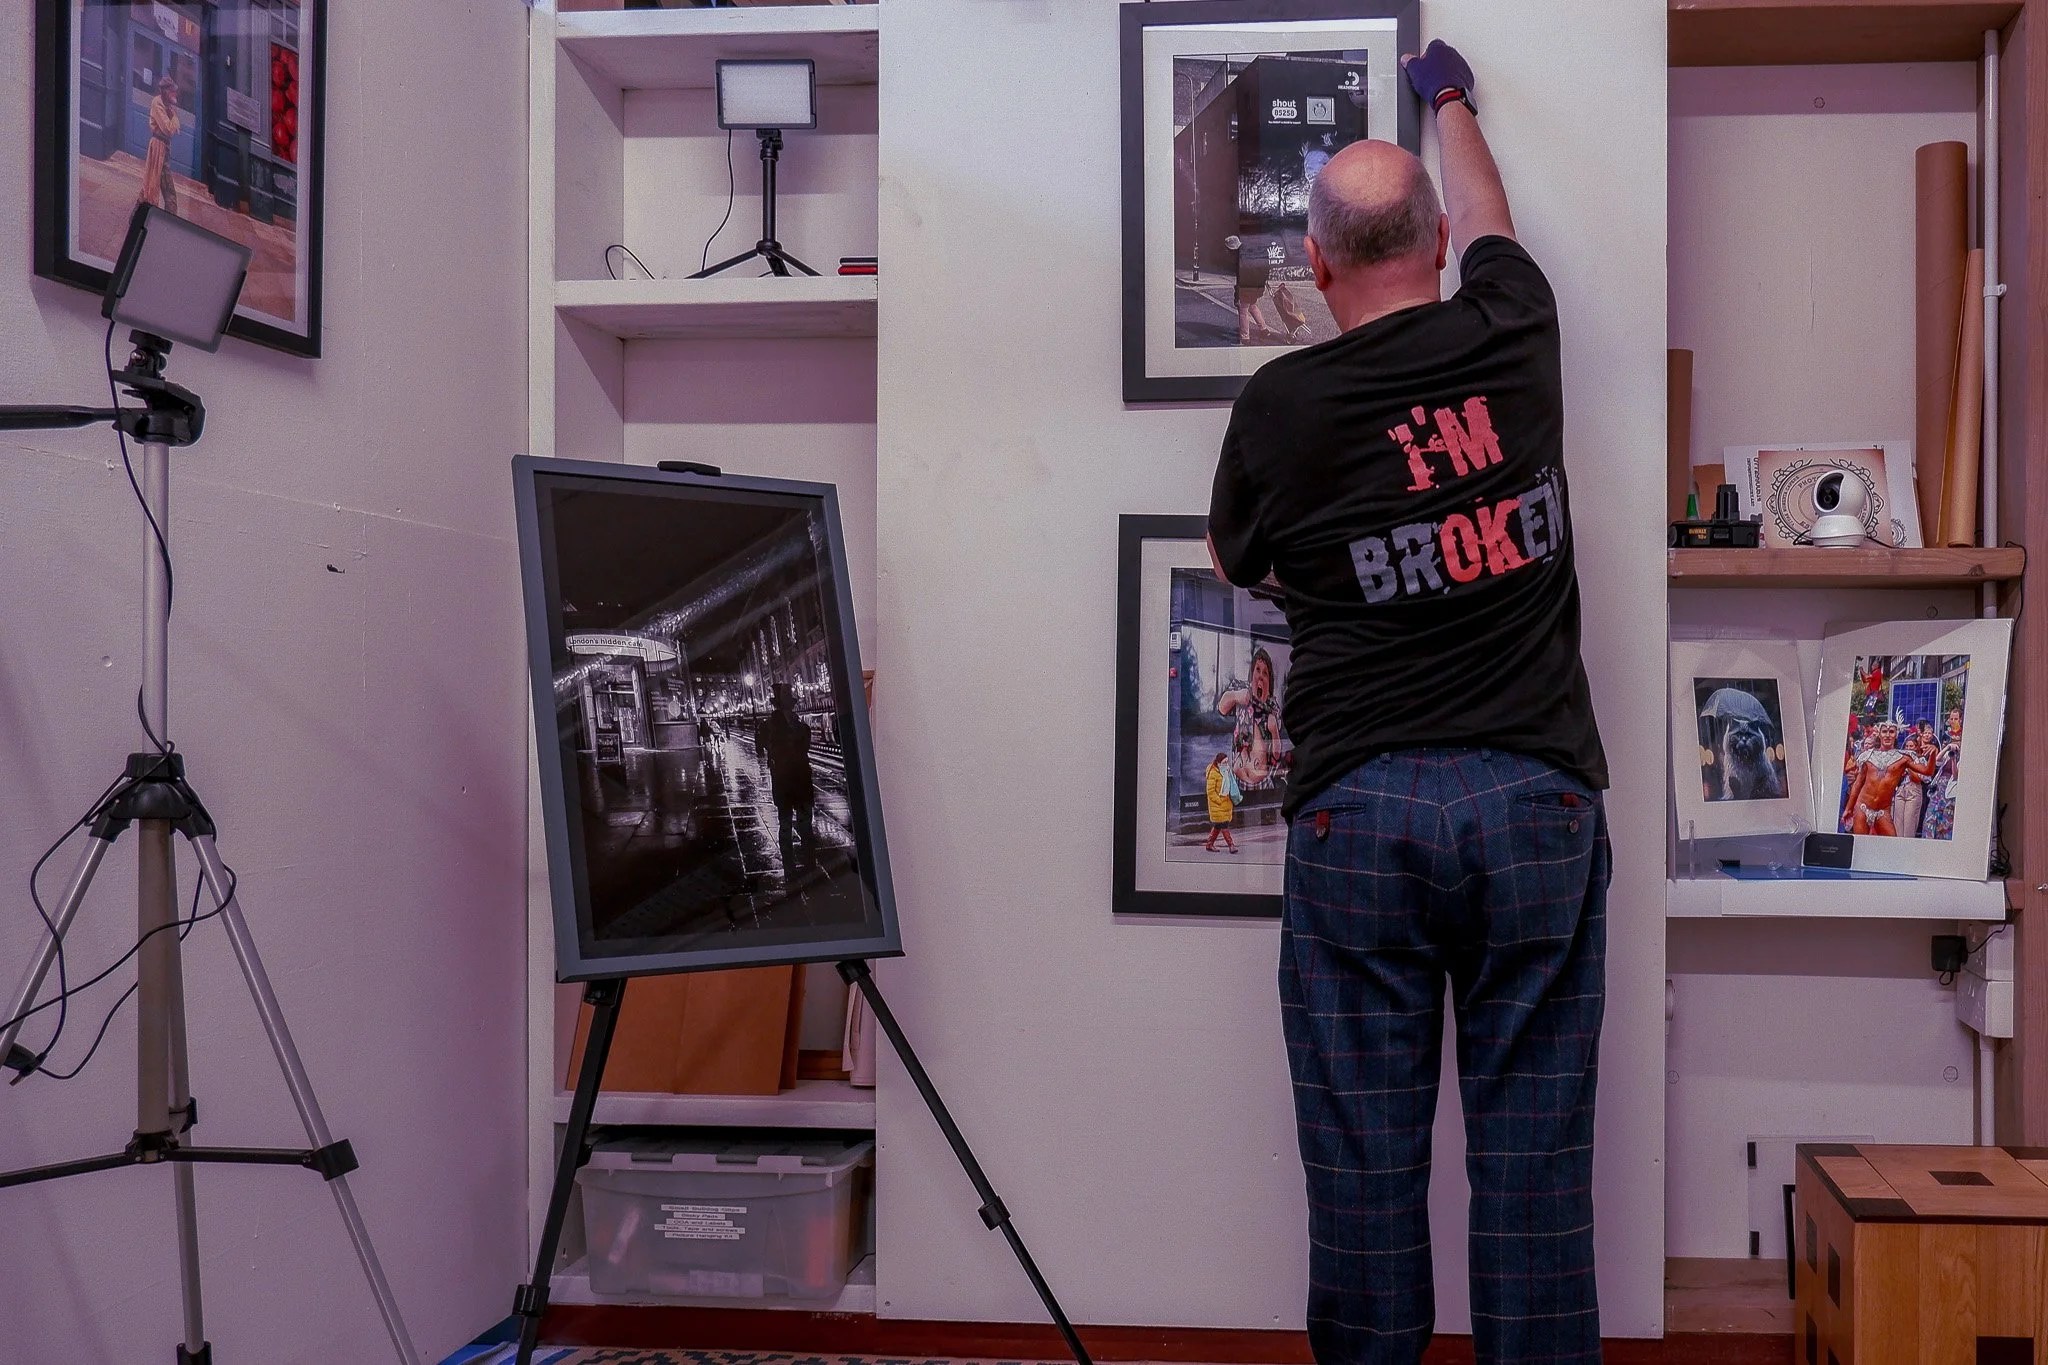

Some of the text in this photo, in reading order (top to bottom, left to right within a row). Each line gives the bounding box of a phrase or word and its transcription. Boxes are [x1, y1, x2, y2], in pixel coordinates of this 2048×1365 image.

[1272, 98, 1297, 108] shout
[1388, 396, 1504, 492] I'M
[1348, 470, 1564, 604] BROKEN
[569, 637, 599, 646] London's
